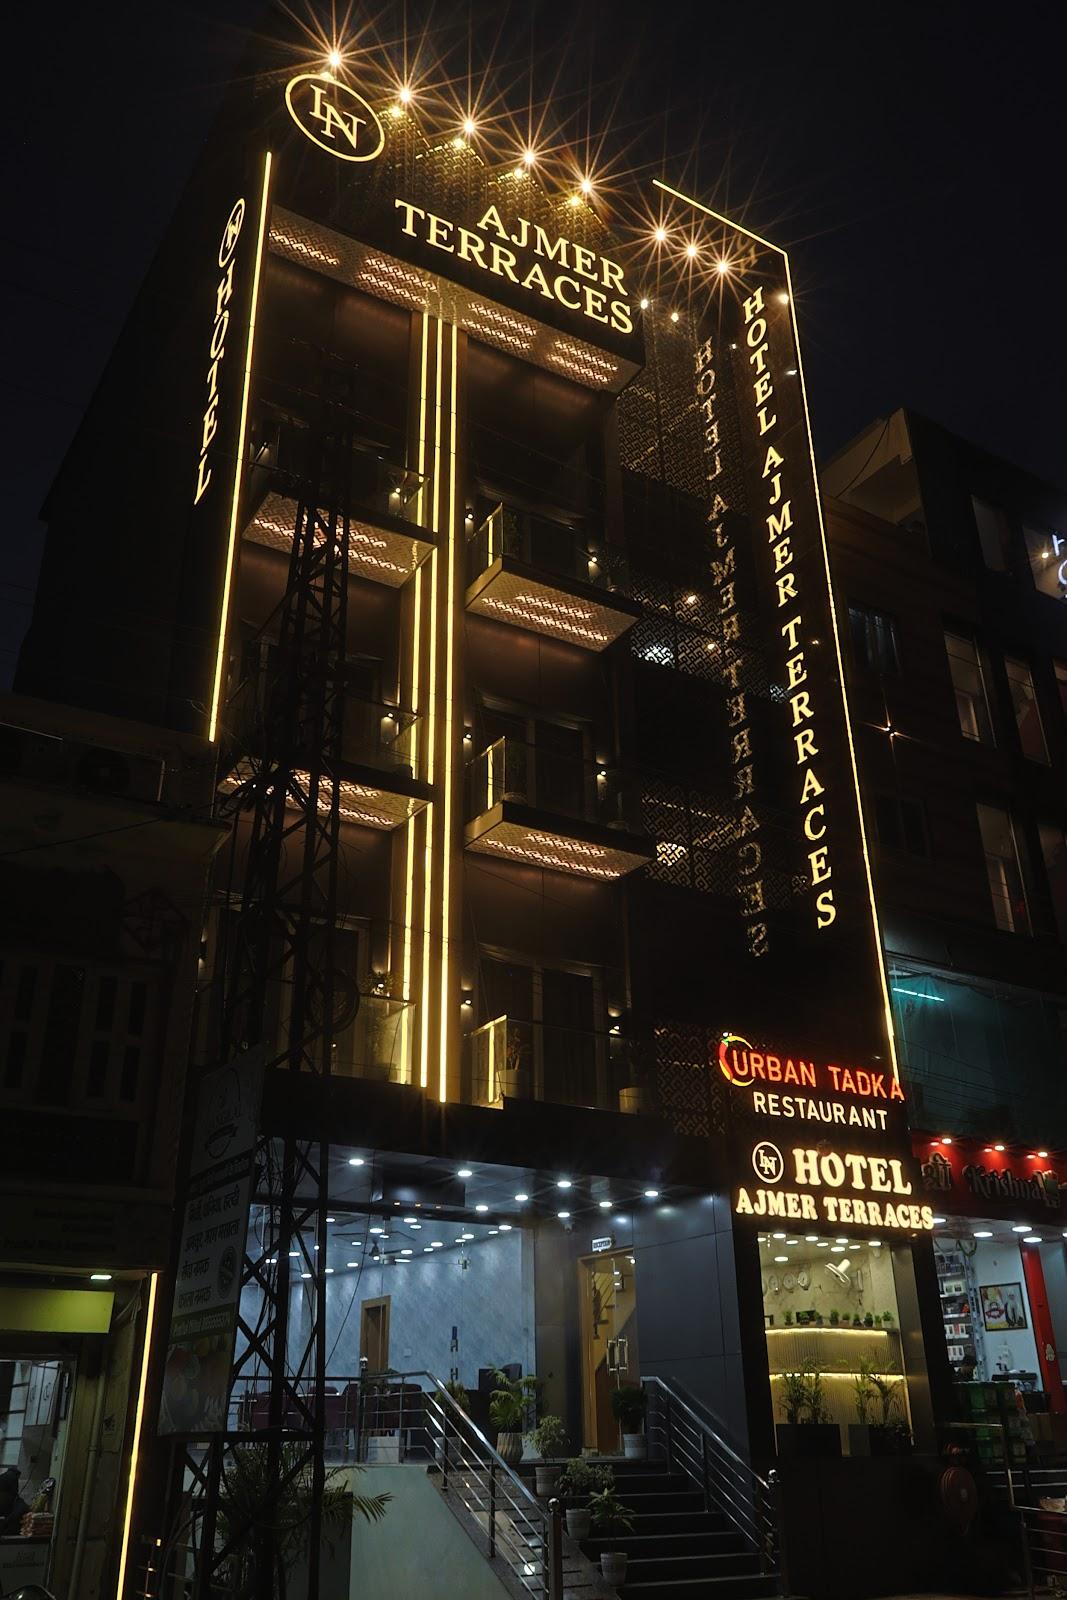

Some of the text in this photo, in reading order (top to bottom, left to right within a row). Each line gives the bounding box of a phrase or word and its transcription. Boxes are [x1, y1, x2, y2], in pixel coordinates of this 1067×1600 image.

[395, 199, 634, 334] TERRACES
[476, 205, 629, 296] AJMER
[193, 258, 236, 505] HOTEL
[743, 286, 837, 929] HOTEL AJMER TERRACES
[732, 1049, 905, 1101] URBAN TADKA
[753, 1091, 888, 1130] RESTAURANT
[792, 1148, 912, 1195] HOTEL
[736, 1187, 935, 1230] AJMER TERRACES
